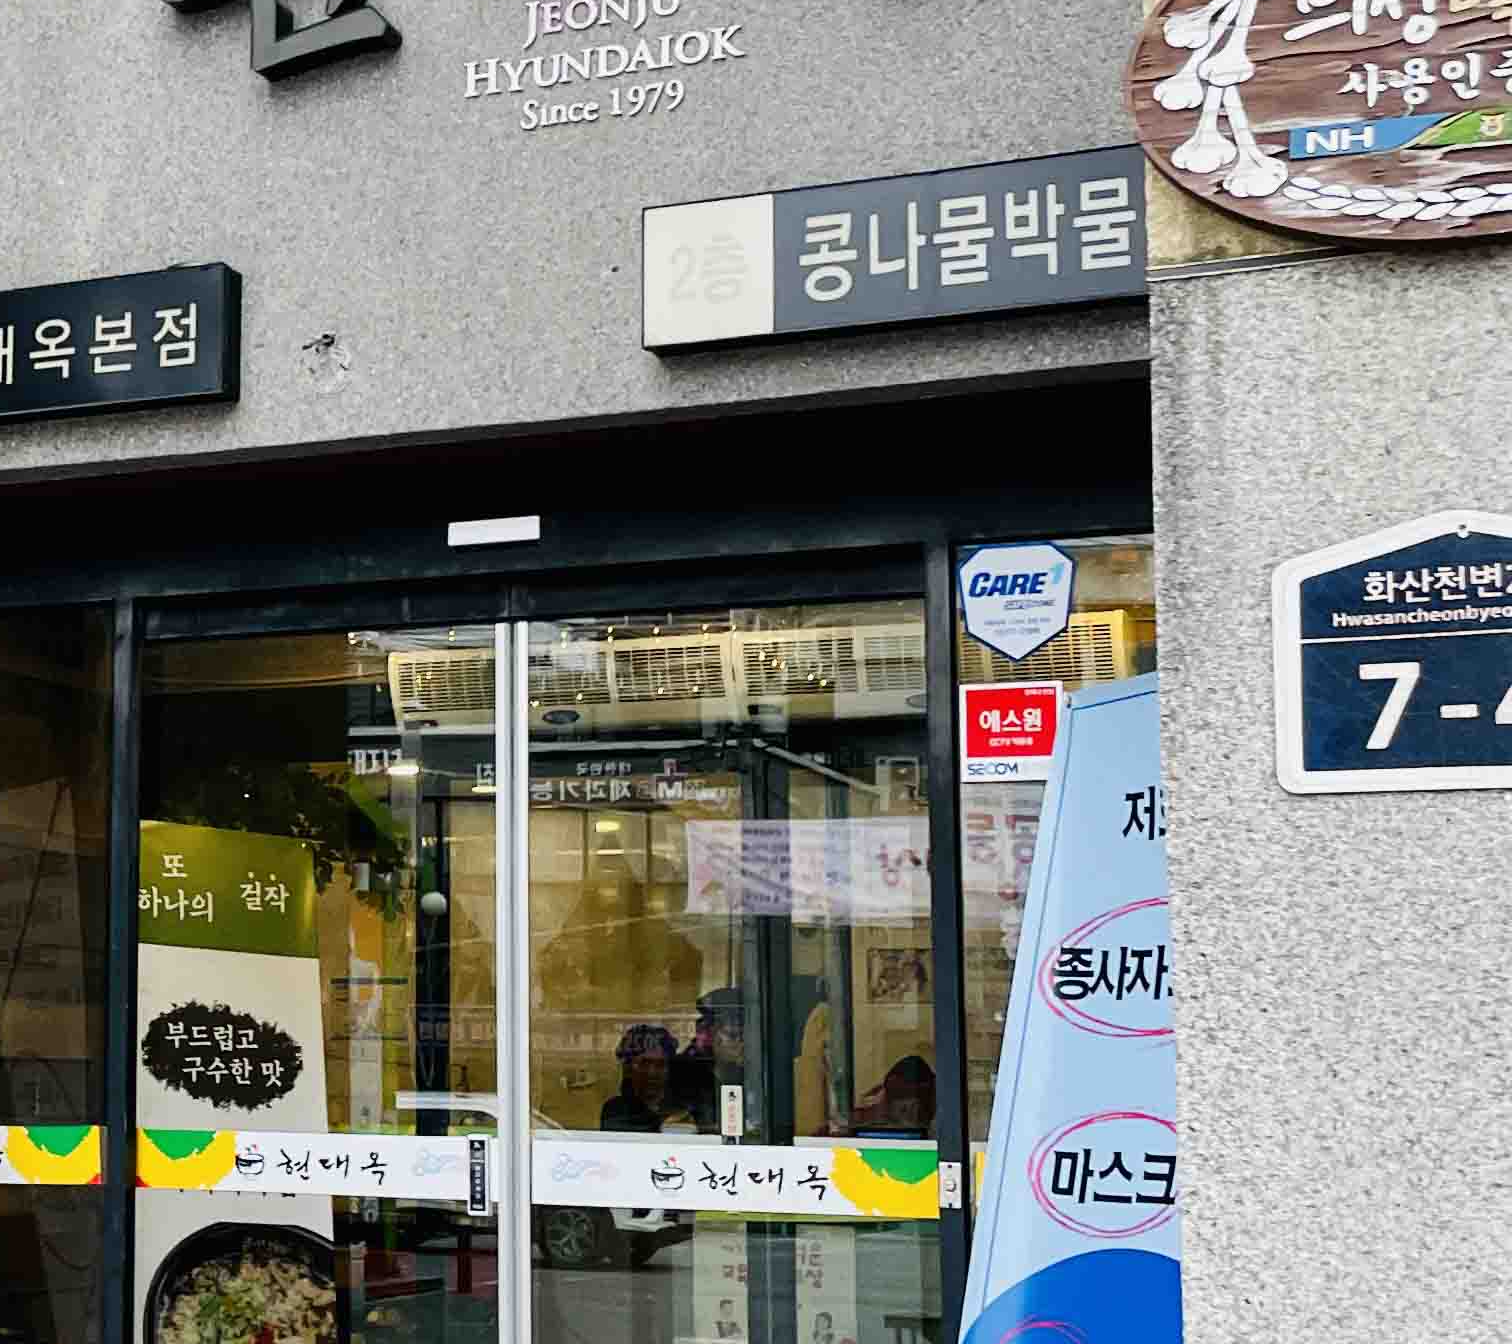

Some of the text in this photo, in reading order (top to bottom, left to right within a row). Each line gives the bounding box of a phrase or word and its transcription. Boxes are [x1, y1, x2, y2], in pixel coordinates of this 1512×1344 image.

[463, 24, 748, 99] HYUNDAIOK
[520, 79, 686, 131] Since 1979
[1305, 125, 1375, 155] NH
[1363, 562, 1512, 605] 화산천변
[979, 707, 1042, 733] 에스원
[1122, 785, 1166, 841] 저
[161, 853, 189, 879] 또
[138, 880, 291, 924] 하나의 걸작
[1051, 945, 1175, 1001] 종사자
[164, 1022, 260, 1053] 부드럽고
[181, 1056, 286, 1088] 구수한 맛
[276, 1148, 390, 1186] 현대옥
[698, 1160, 830, 1201] 현대옥
